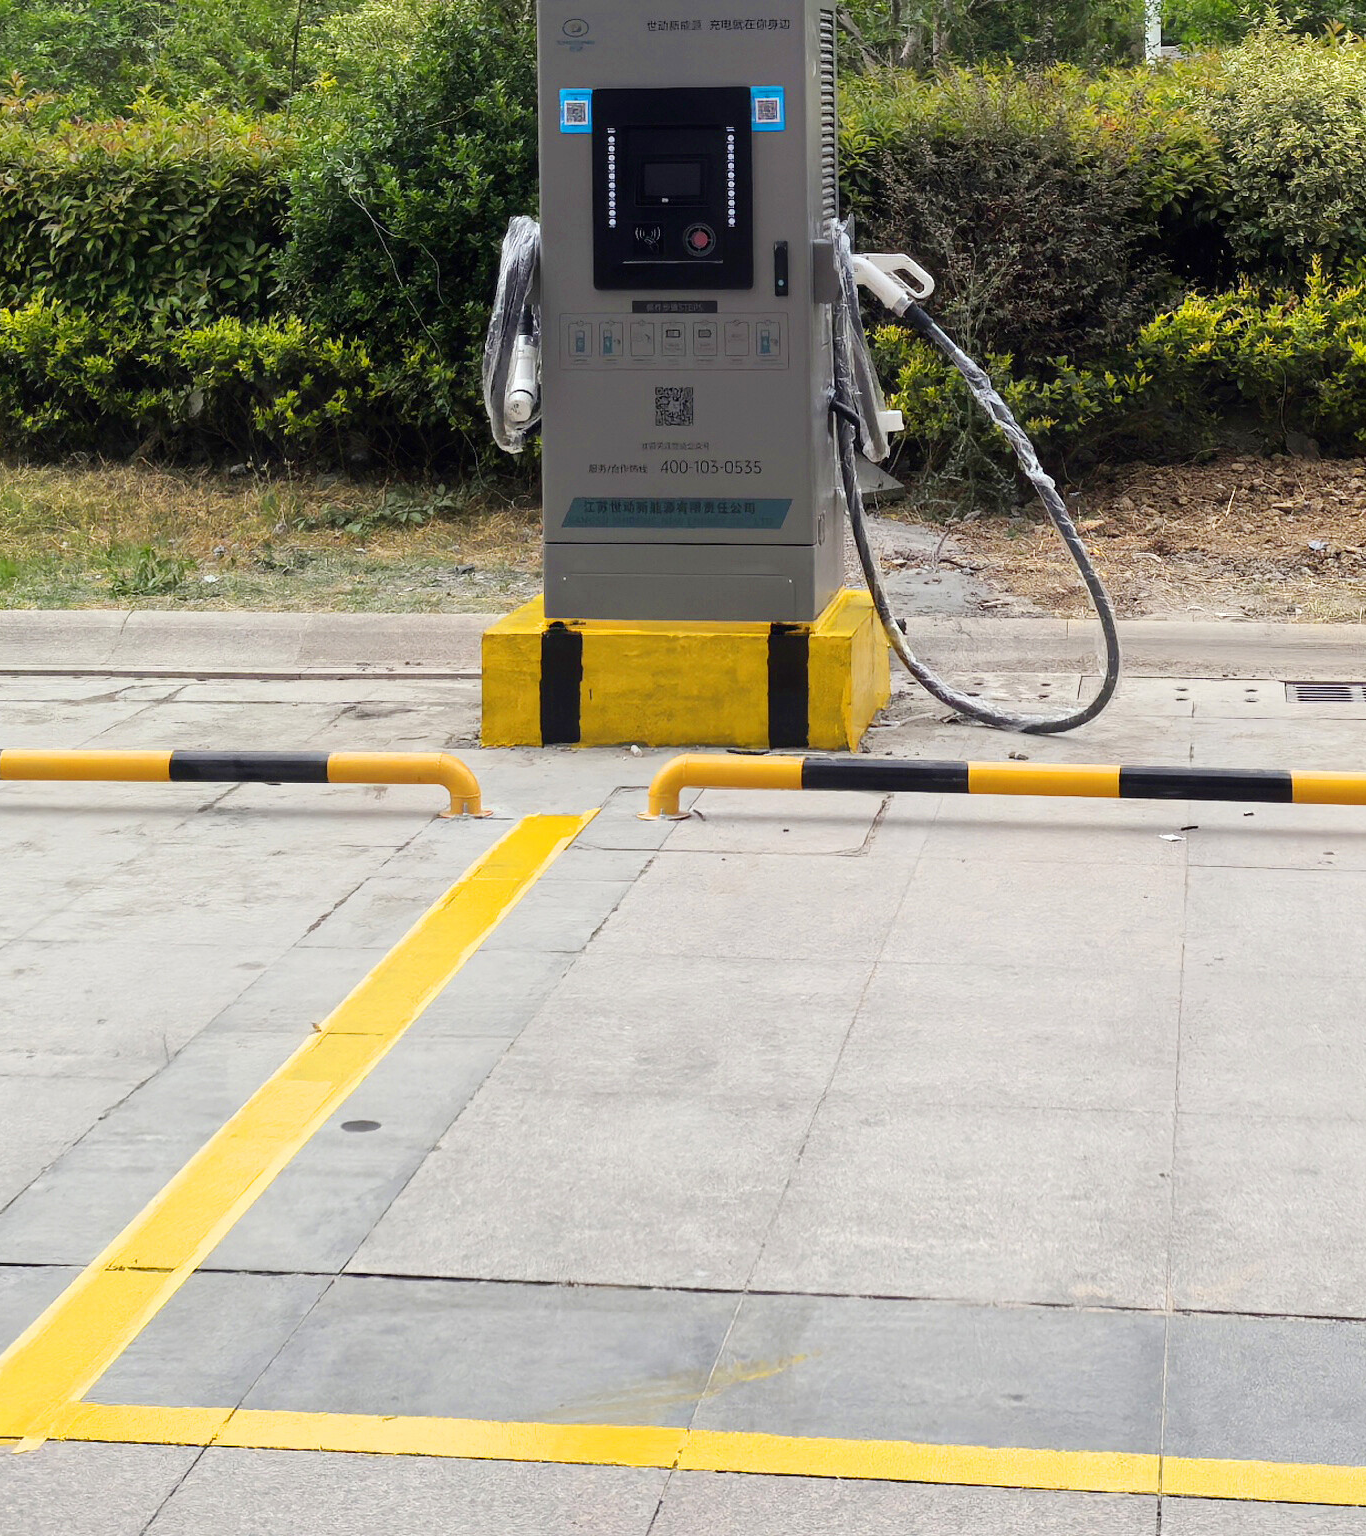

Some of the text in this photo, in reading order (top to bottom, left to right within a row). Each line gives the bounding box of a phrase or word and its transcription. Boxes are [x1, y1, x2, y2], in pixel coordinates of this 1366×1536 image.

[660, 460, 763, 475] 400-103-0535
[583, 500, 756, 514] 江苏世动新能源有限责任公司
